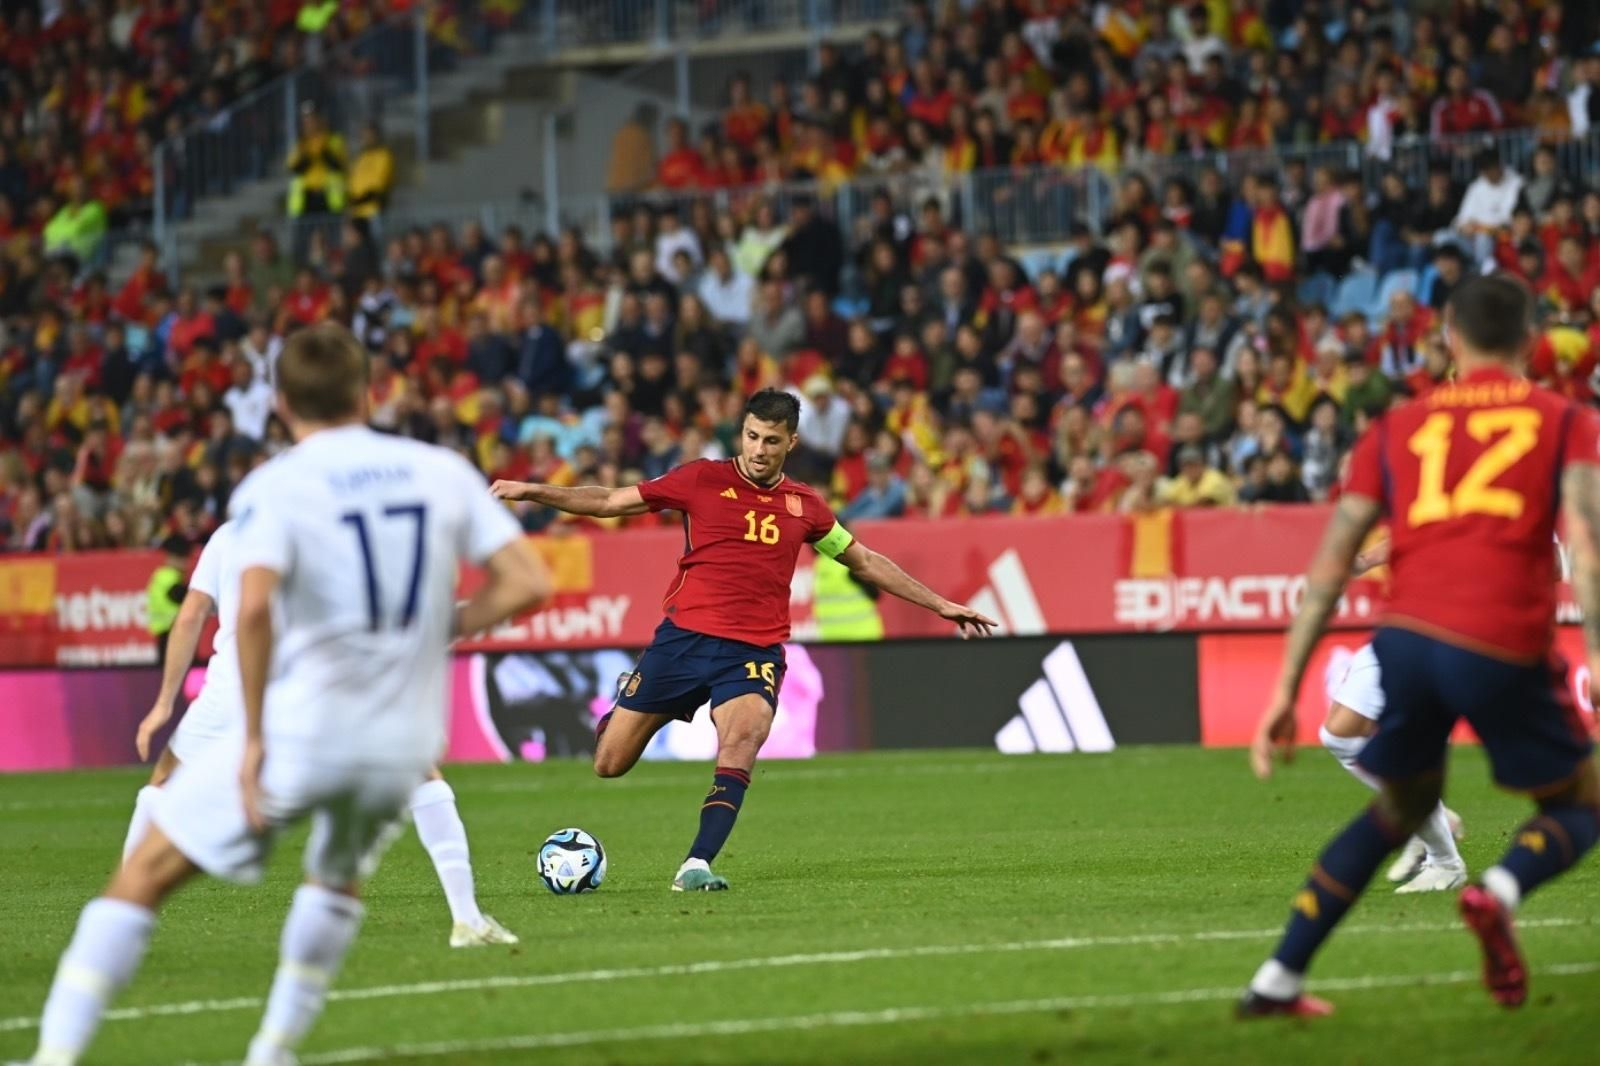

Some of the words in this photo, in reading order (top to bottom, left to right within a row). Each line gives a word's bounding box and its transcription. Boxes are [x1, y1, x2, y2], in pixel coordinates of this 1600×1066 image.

[1407, 405, 1542, 529] 12
[744, 510, 780, 545] 16
[340, 502, 427, 632] 17
[1178, 575, 1372, 620] FACTO
[744, 661, 776, 687] 16
